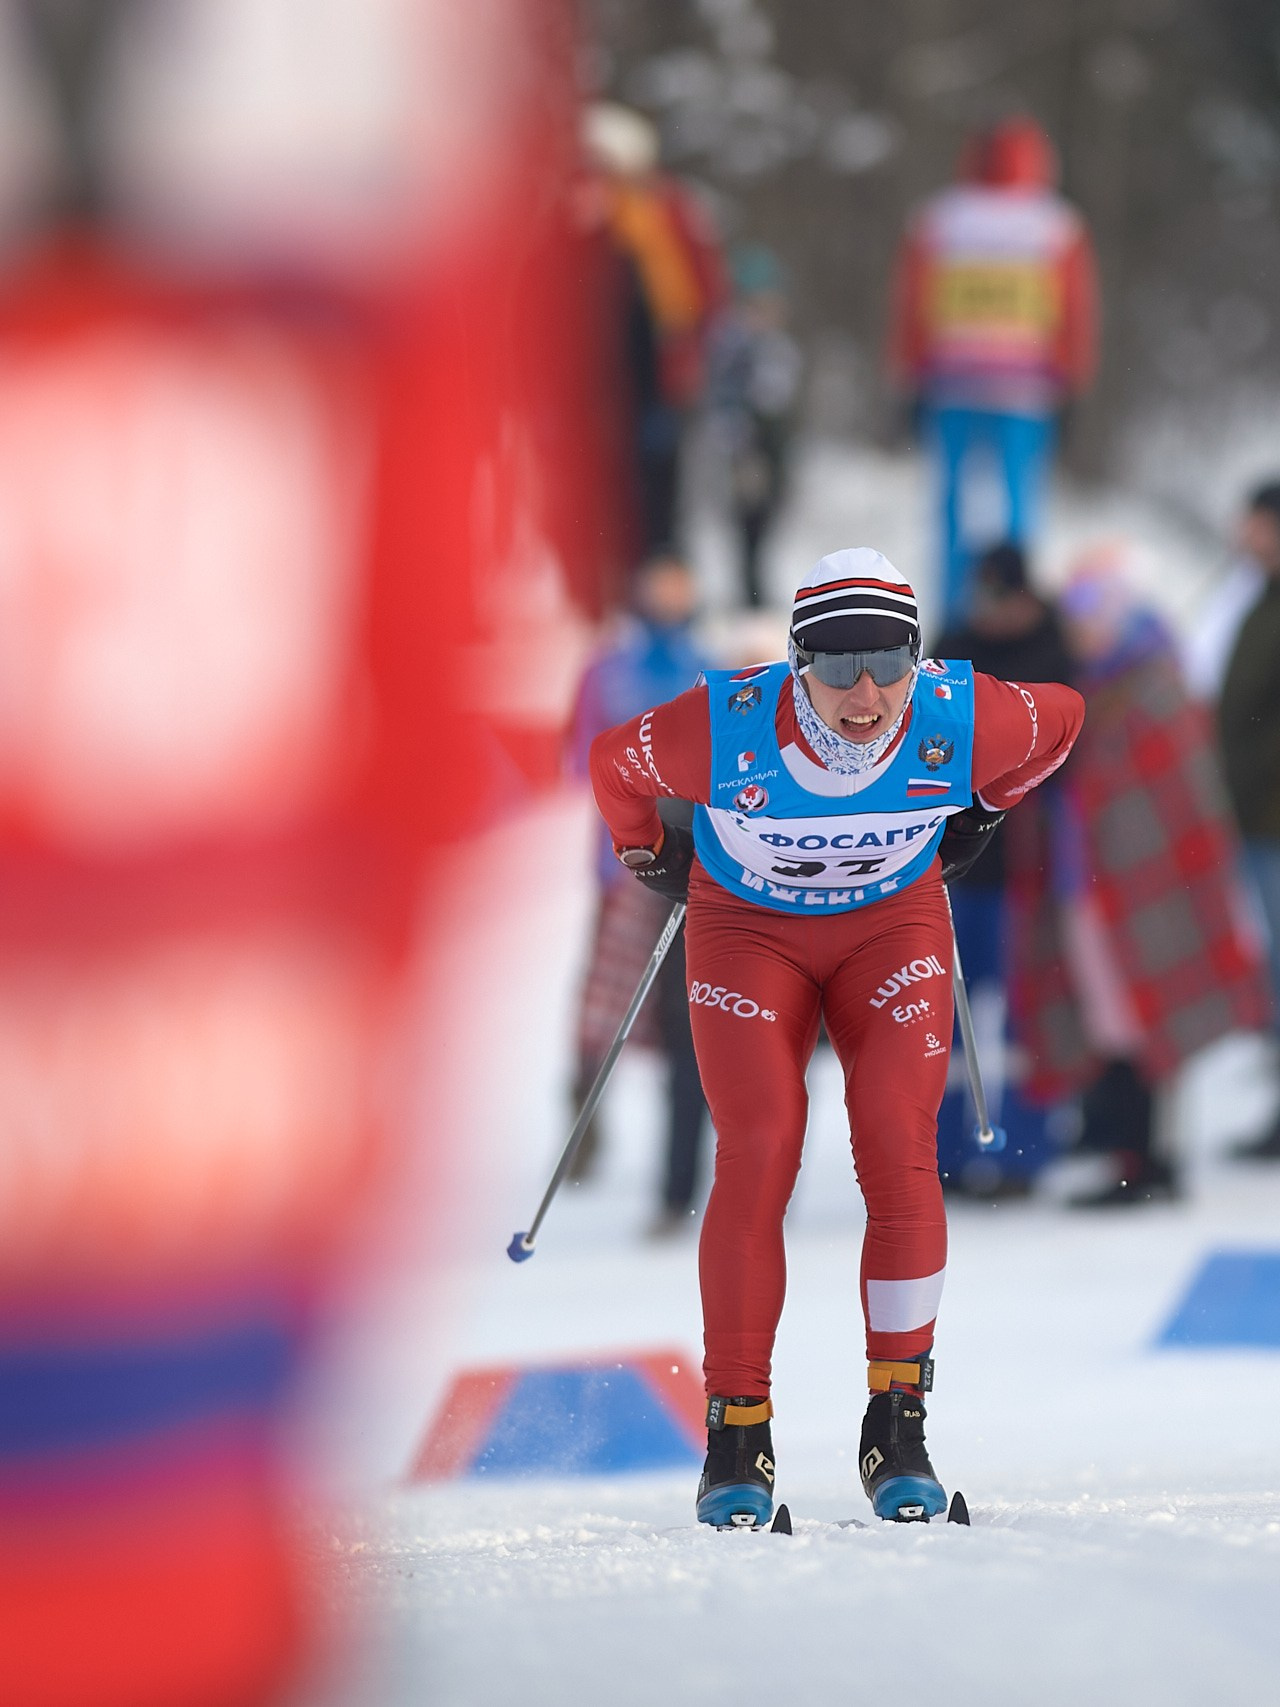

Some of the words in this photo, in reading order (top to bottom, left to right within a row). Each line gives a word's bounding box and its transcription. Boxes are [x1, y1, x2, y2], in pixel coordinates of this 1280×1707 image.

[717, 769, 779, 790] РУСКЛИМАТ
[869, 954, 947, 1009] LUKOIL
[689, 980, 760, 1018] BOSCO
[710, 1399, 721, 1423] 222
